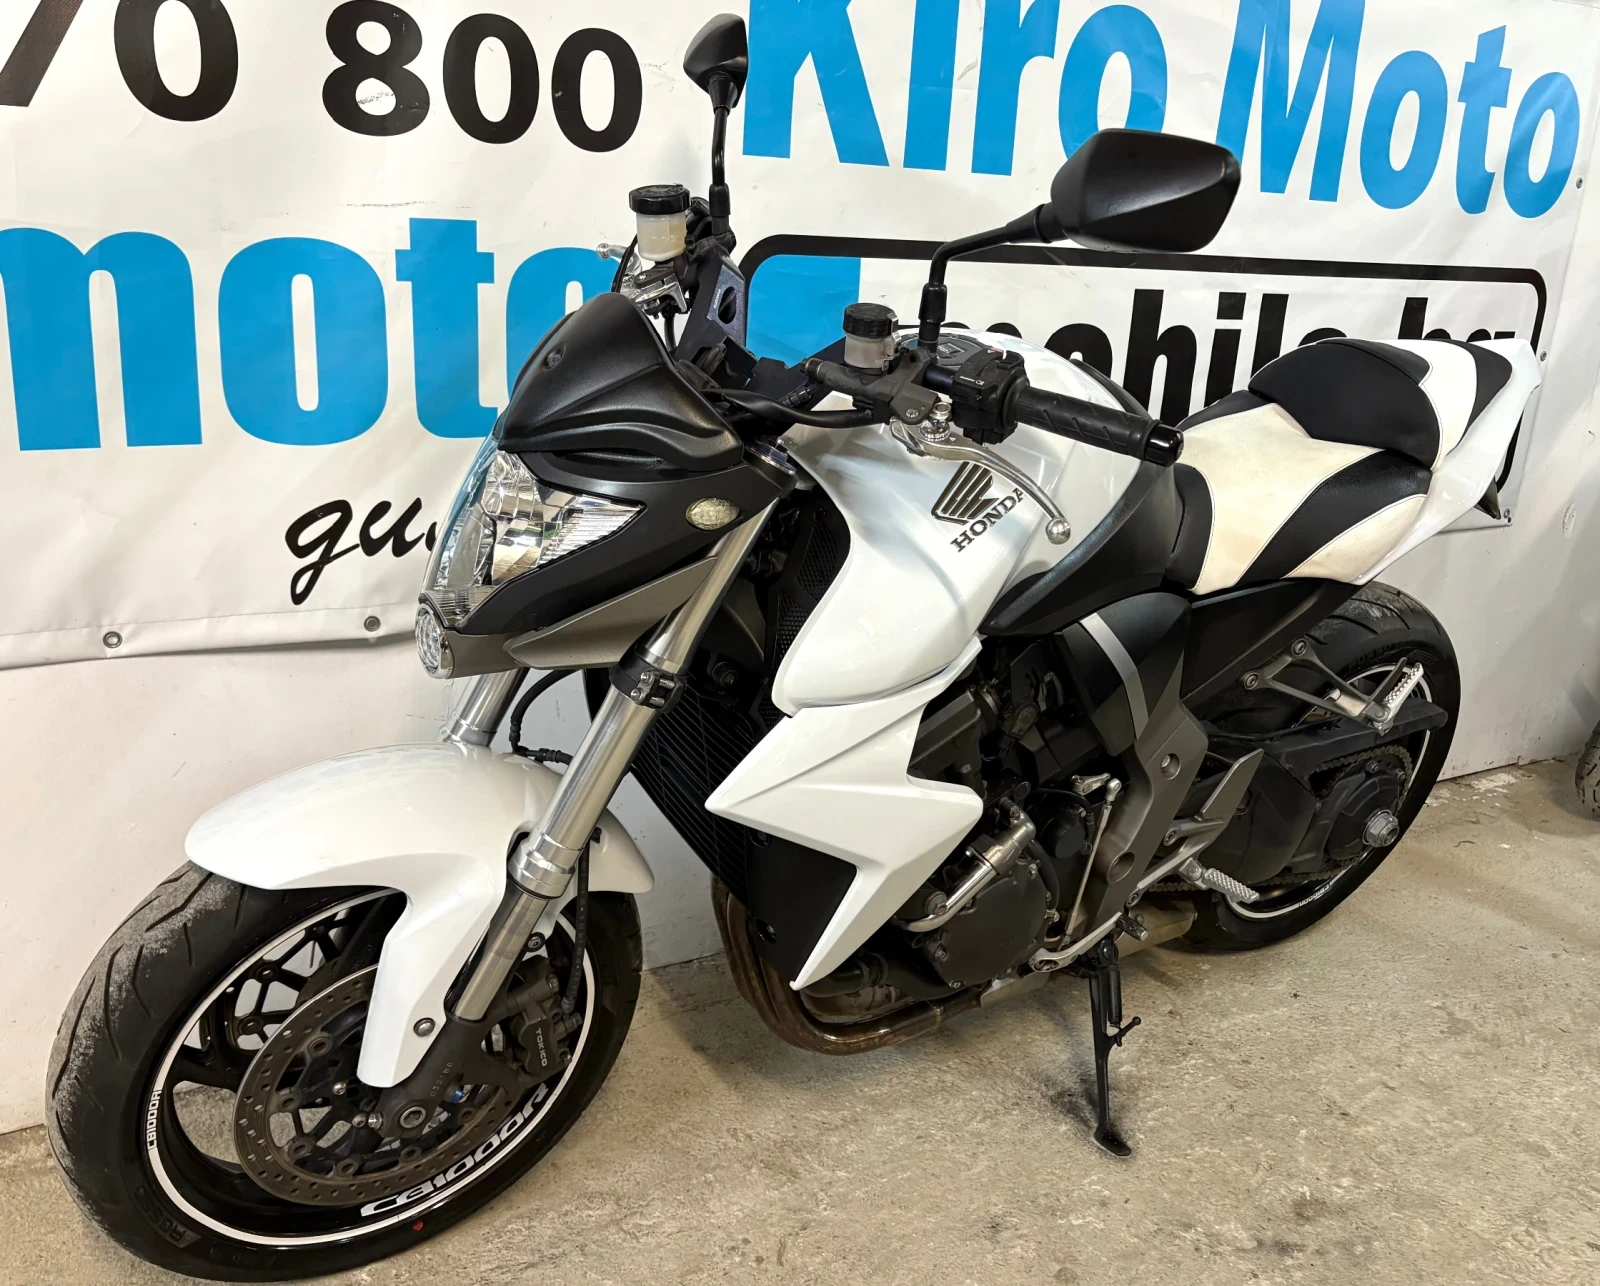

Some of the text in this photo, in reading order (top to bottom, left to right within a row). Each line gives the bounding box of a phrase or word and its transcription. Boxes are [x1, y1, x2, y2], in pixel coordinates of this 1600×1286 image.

[322, 0, 642, 153] 800
[1215, 0, 1580, 219] Moto
[285, 497, 437, 606] gu
[950, 487, 1024, 553] HONDA
[535, 1027, 548, 1067] TOKICO
[146, 1090, 162, 1151] CB1000R
